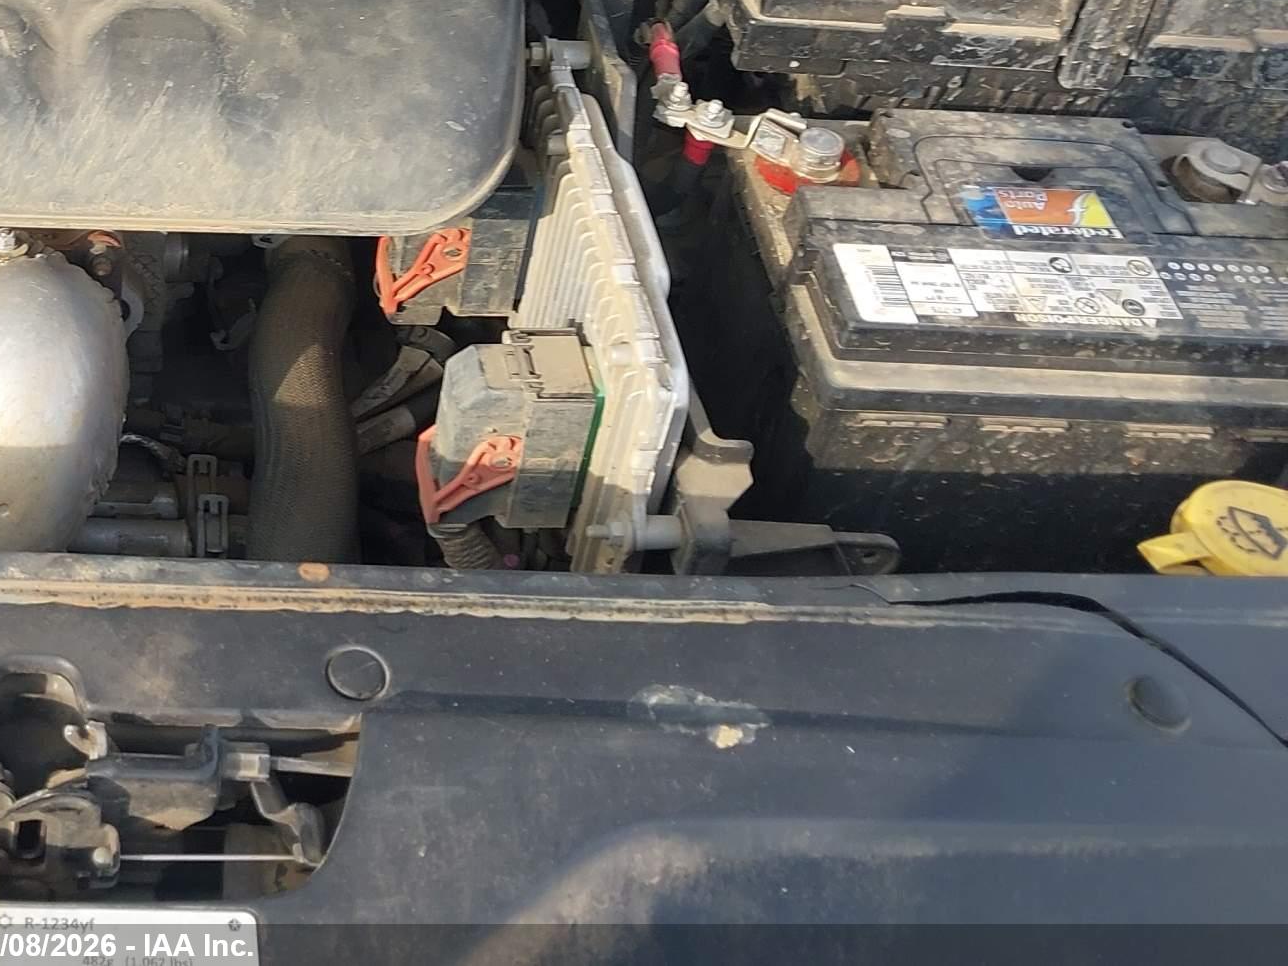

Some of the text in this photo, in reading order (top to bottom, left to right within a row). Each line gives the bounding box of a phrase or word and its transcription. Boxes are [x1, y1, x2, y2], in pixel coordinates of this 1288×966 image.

[998, 189, 1048, 202] Parts
[1005, 200, 1046, 211] Auto
[1013, 224, 1125, 240] Federated
[24, 917, 96, 935] R-1234yf
